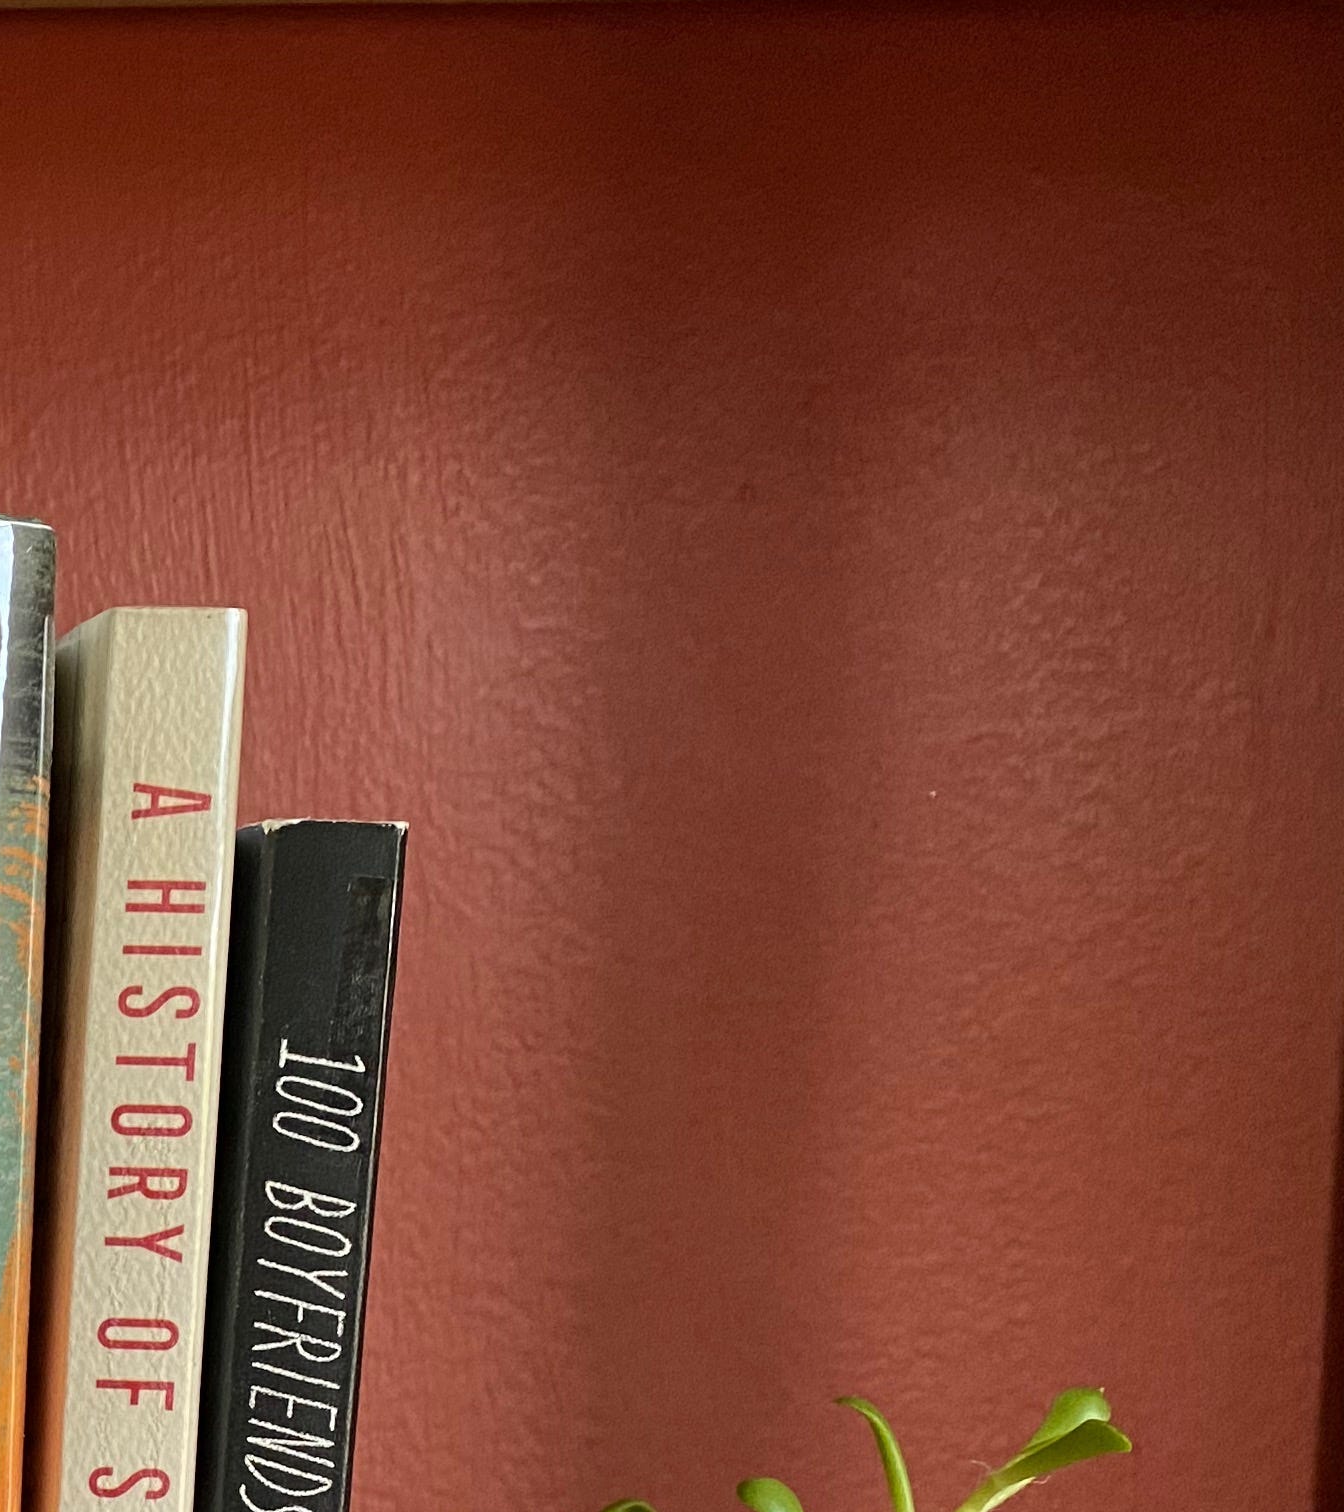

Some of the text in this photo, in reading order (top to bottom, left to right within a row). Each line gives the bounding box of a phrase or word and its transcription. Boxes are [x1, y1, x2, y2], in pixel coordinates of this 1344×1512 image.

[130, 782, 212, 820] A
[104, 879, 207, 1264] HISTORY
[272, 1038, 366, 1153] 100
[95, 1316, 180, 1412] OF
